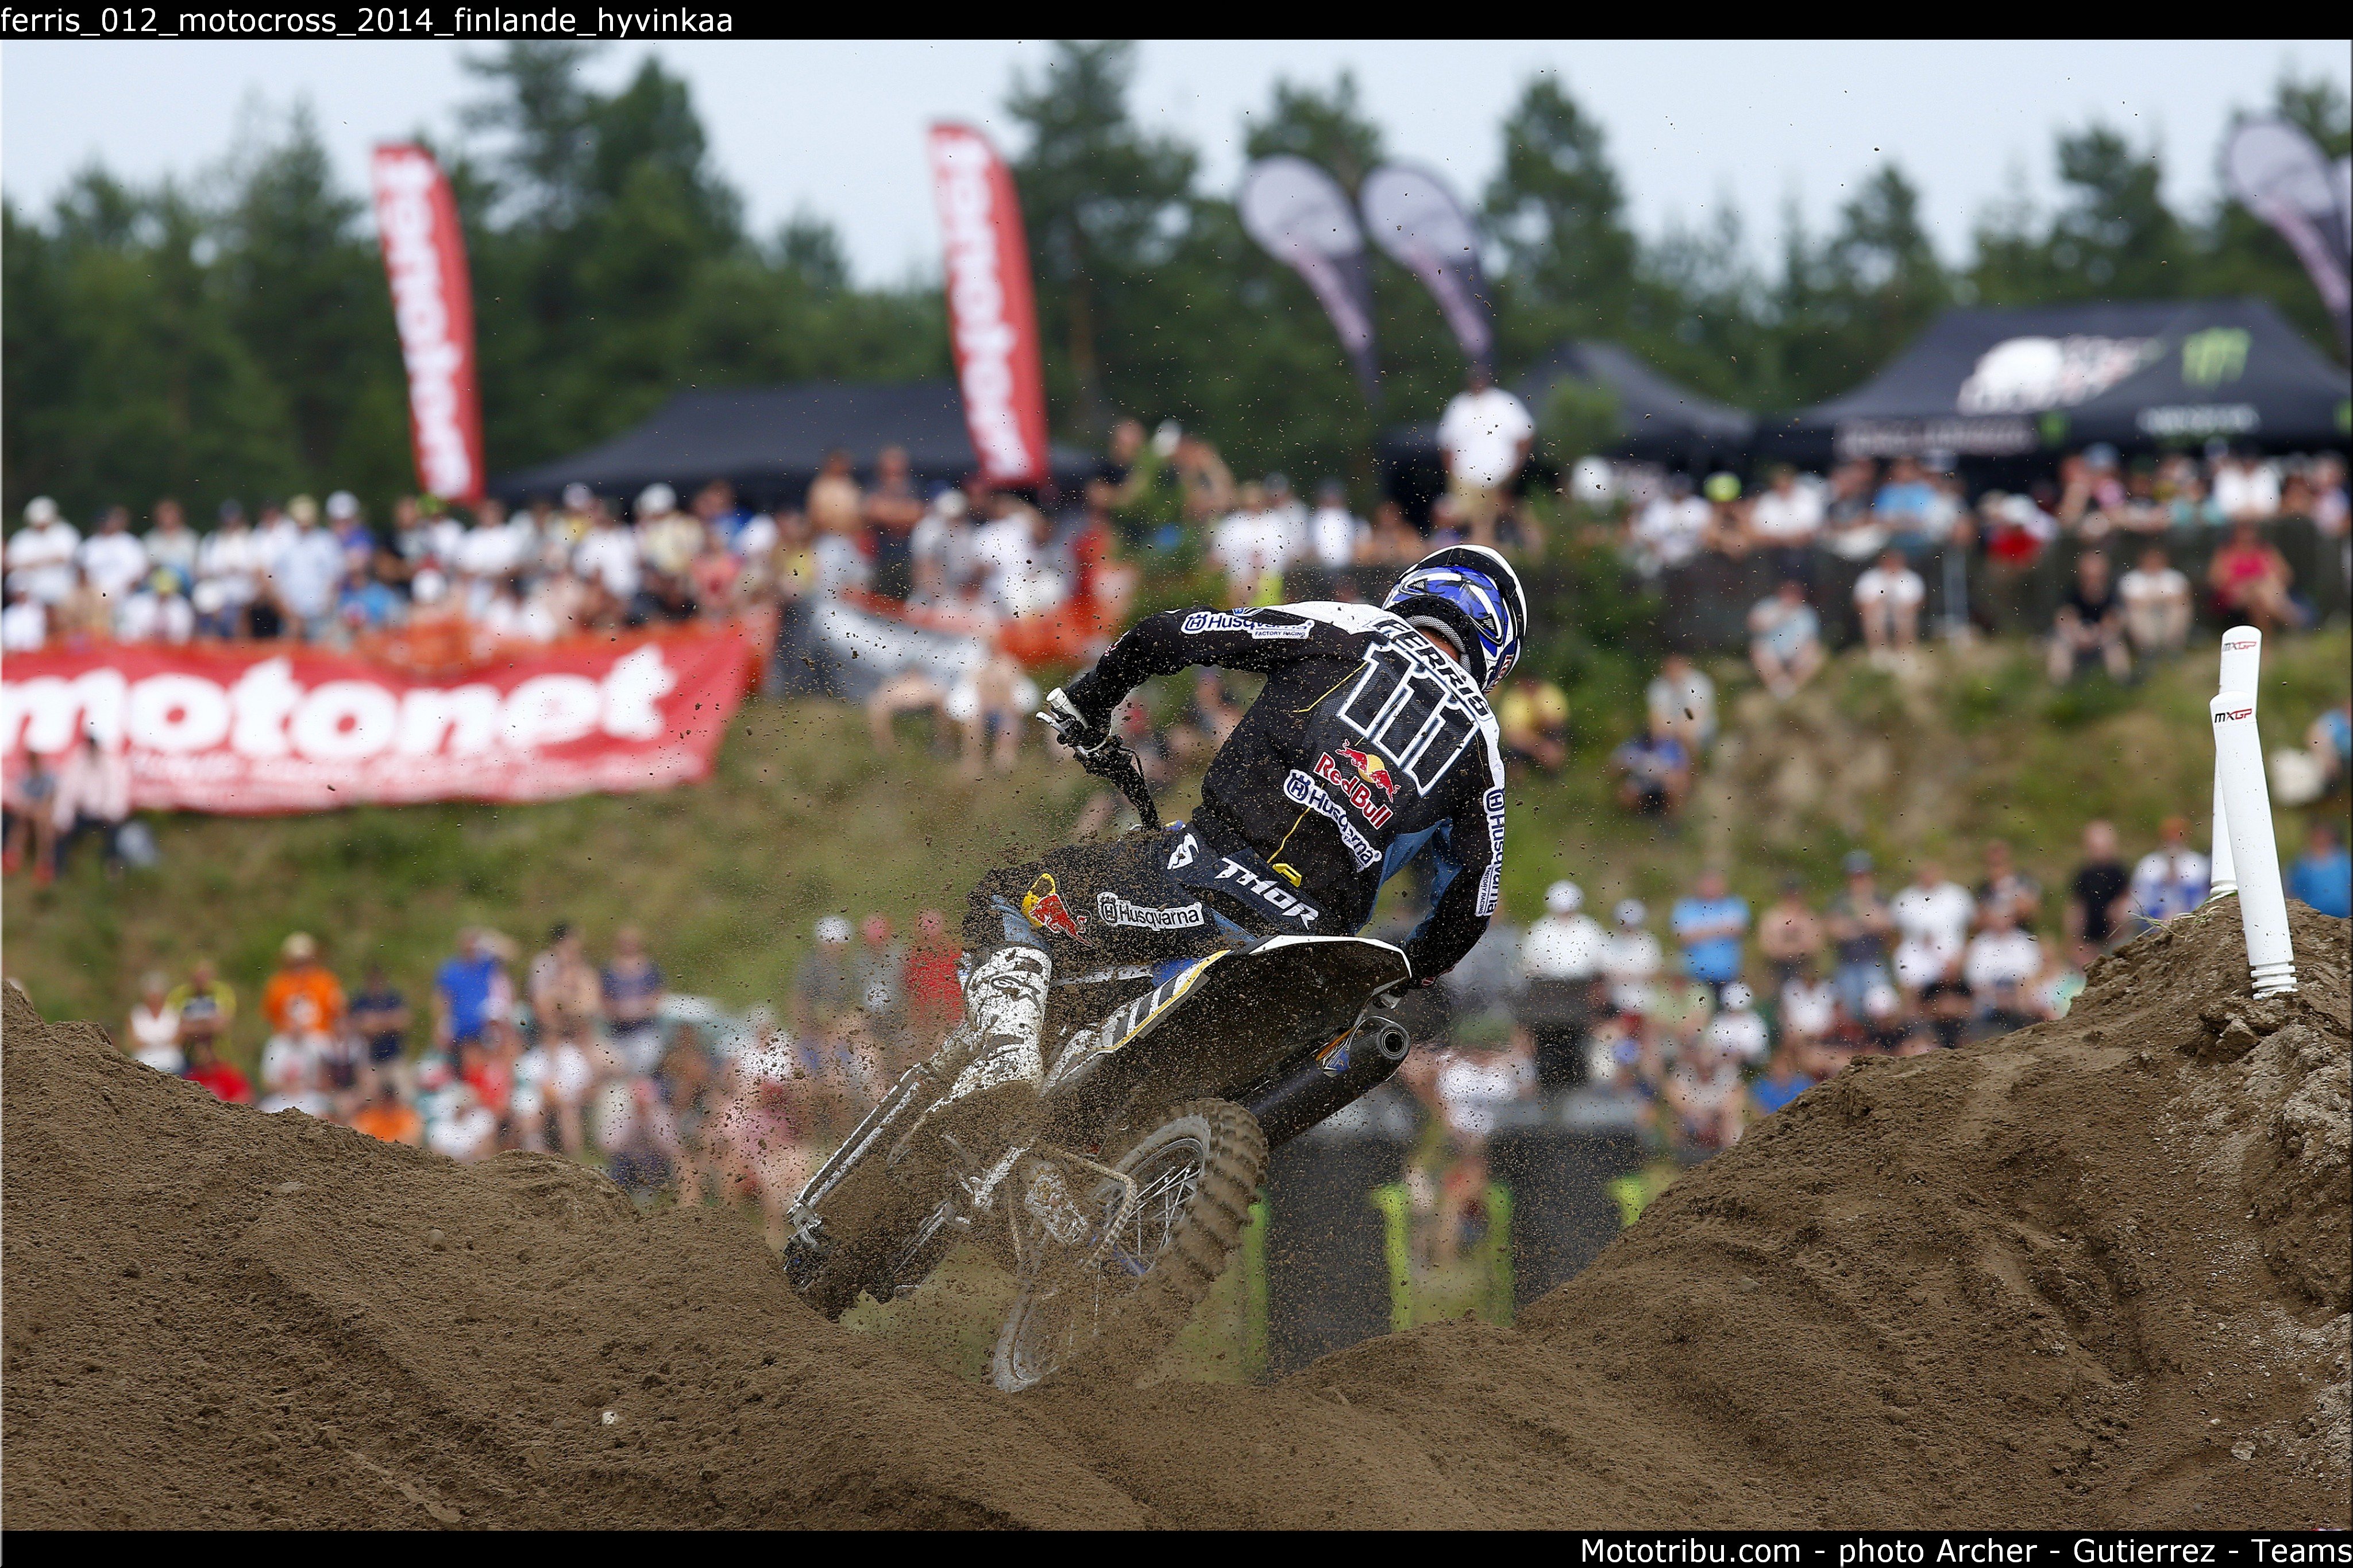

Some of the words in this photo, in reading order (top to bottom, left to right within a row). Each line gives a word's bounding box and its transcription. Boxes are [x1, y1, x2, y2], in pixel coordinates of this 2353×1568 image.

[0, 642, 679, 762] motonet
[1371, 619, 1489, 716] FERRIS
[1335, 639, 1481, 798] 111
[2214, 708, 2252, 724] MXGP
[1308, 789, 1374, 864] Husqrna
[1119, 902, 1200, 928] Husqvarna
[1213, 856, 1319, 930] THOR
